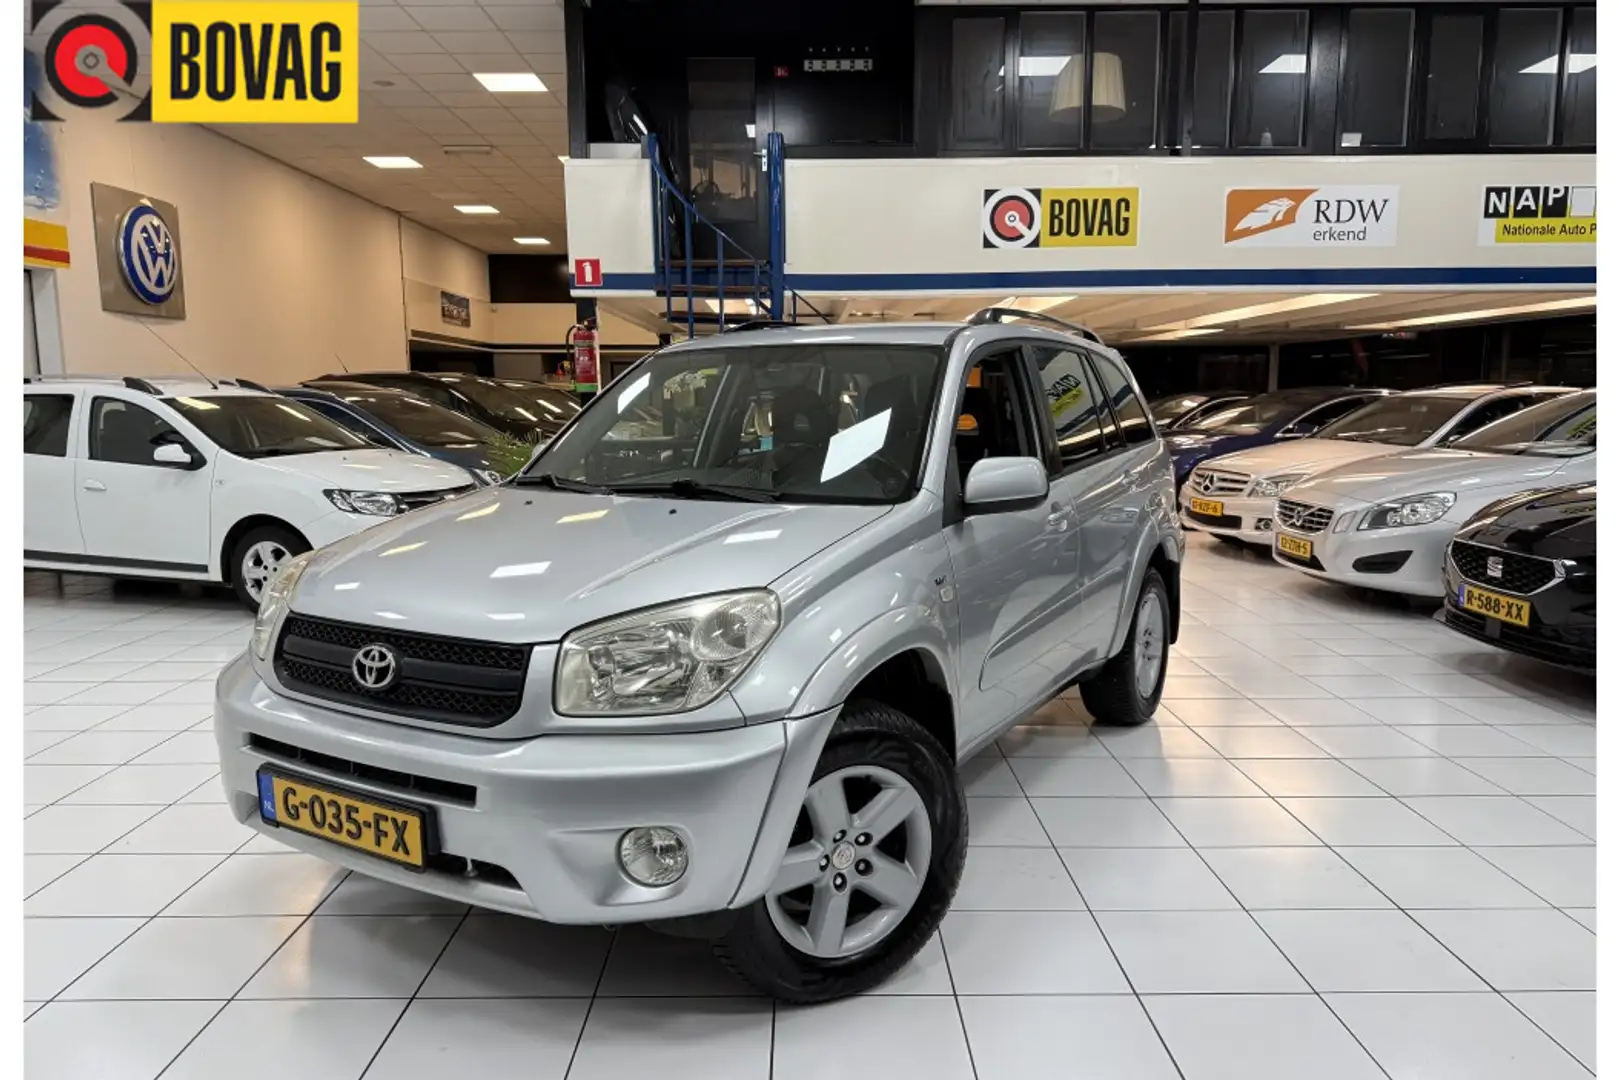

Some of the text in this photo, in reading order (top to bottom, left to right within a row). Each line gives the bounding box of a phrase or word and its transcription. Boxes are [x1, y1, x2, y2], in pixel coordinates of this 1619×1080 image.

[1048, 198, 1131, 237] BOVAG
[1313, 198, 1389, 224] RDW
[1313, 227, 1367, 241] erkend
[1502, 224, 1556, 236] Nationale
[1560, 224, 1587, 235] Auto
[1466, 590, 1524, 621] R-588-XX
[283, 787, 410, 855] G-035-FX
